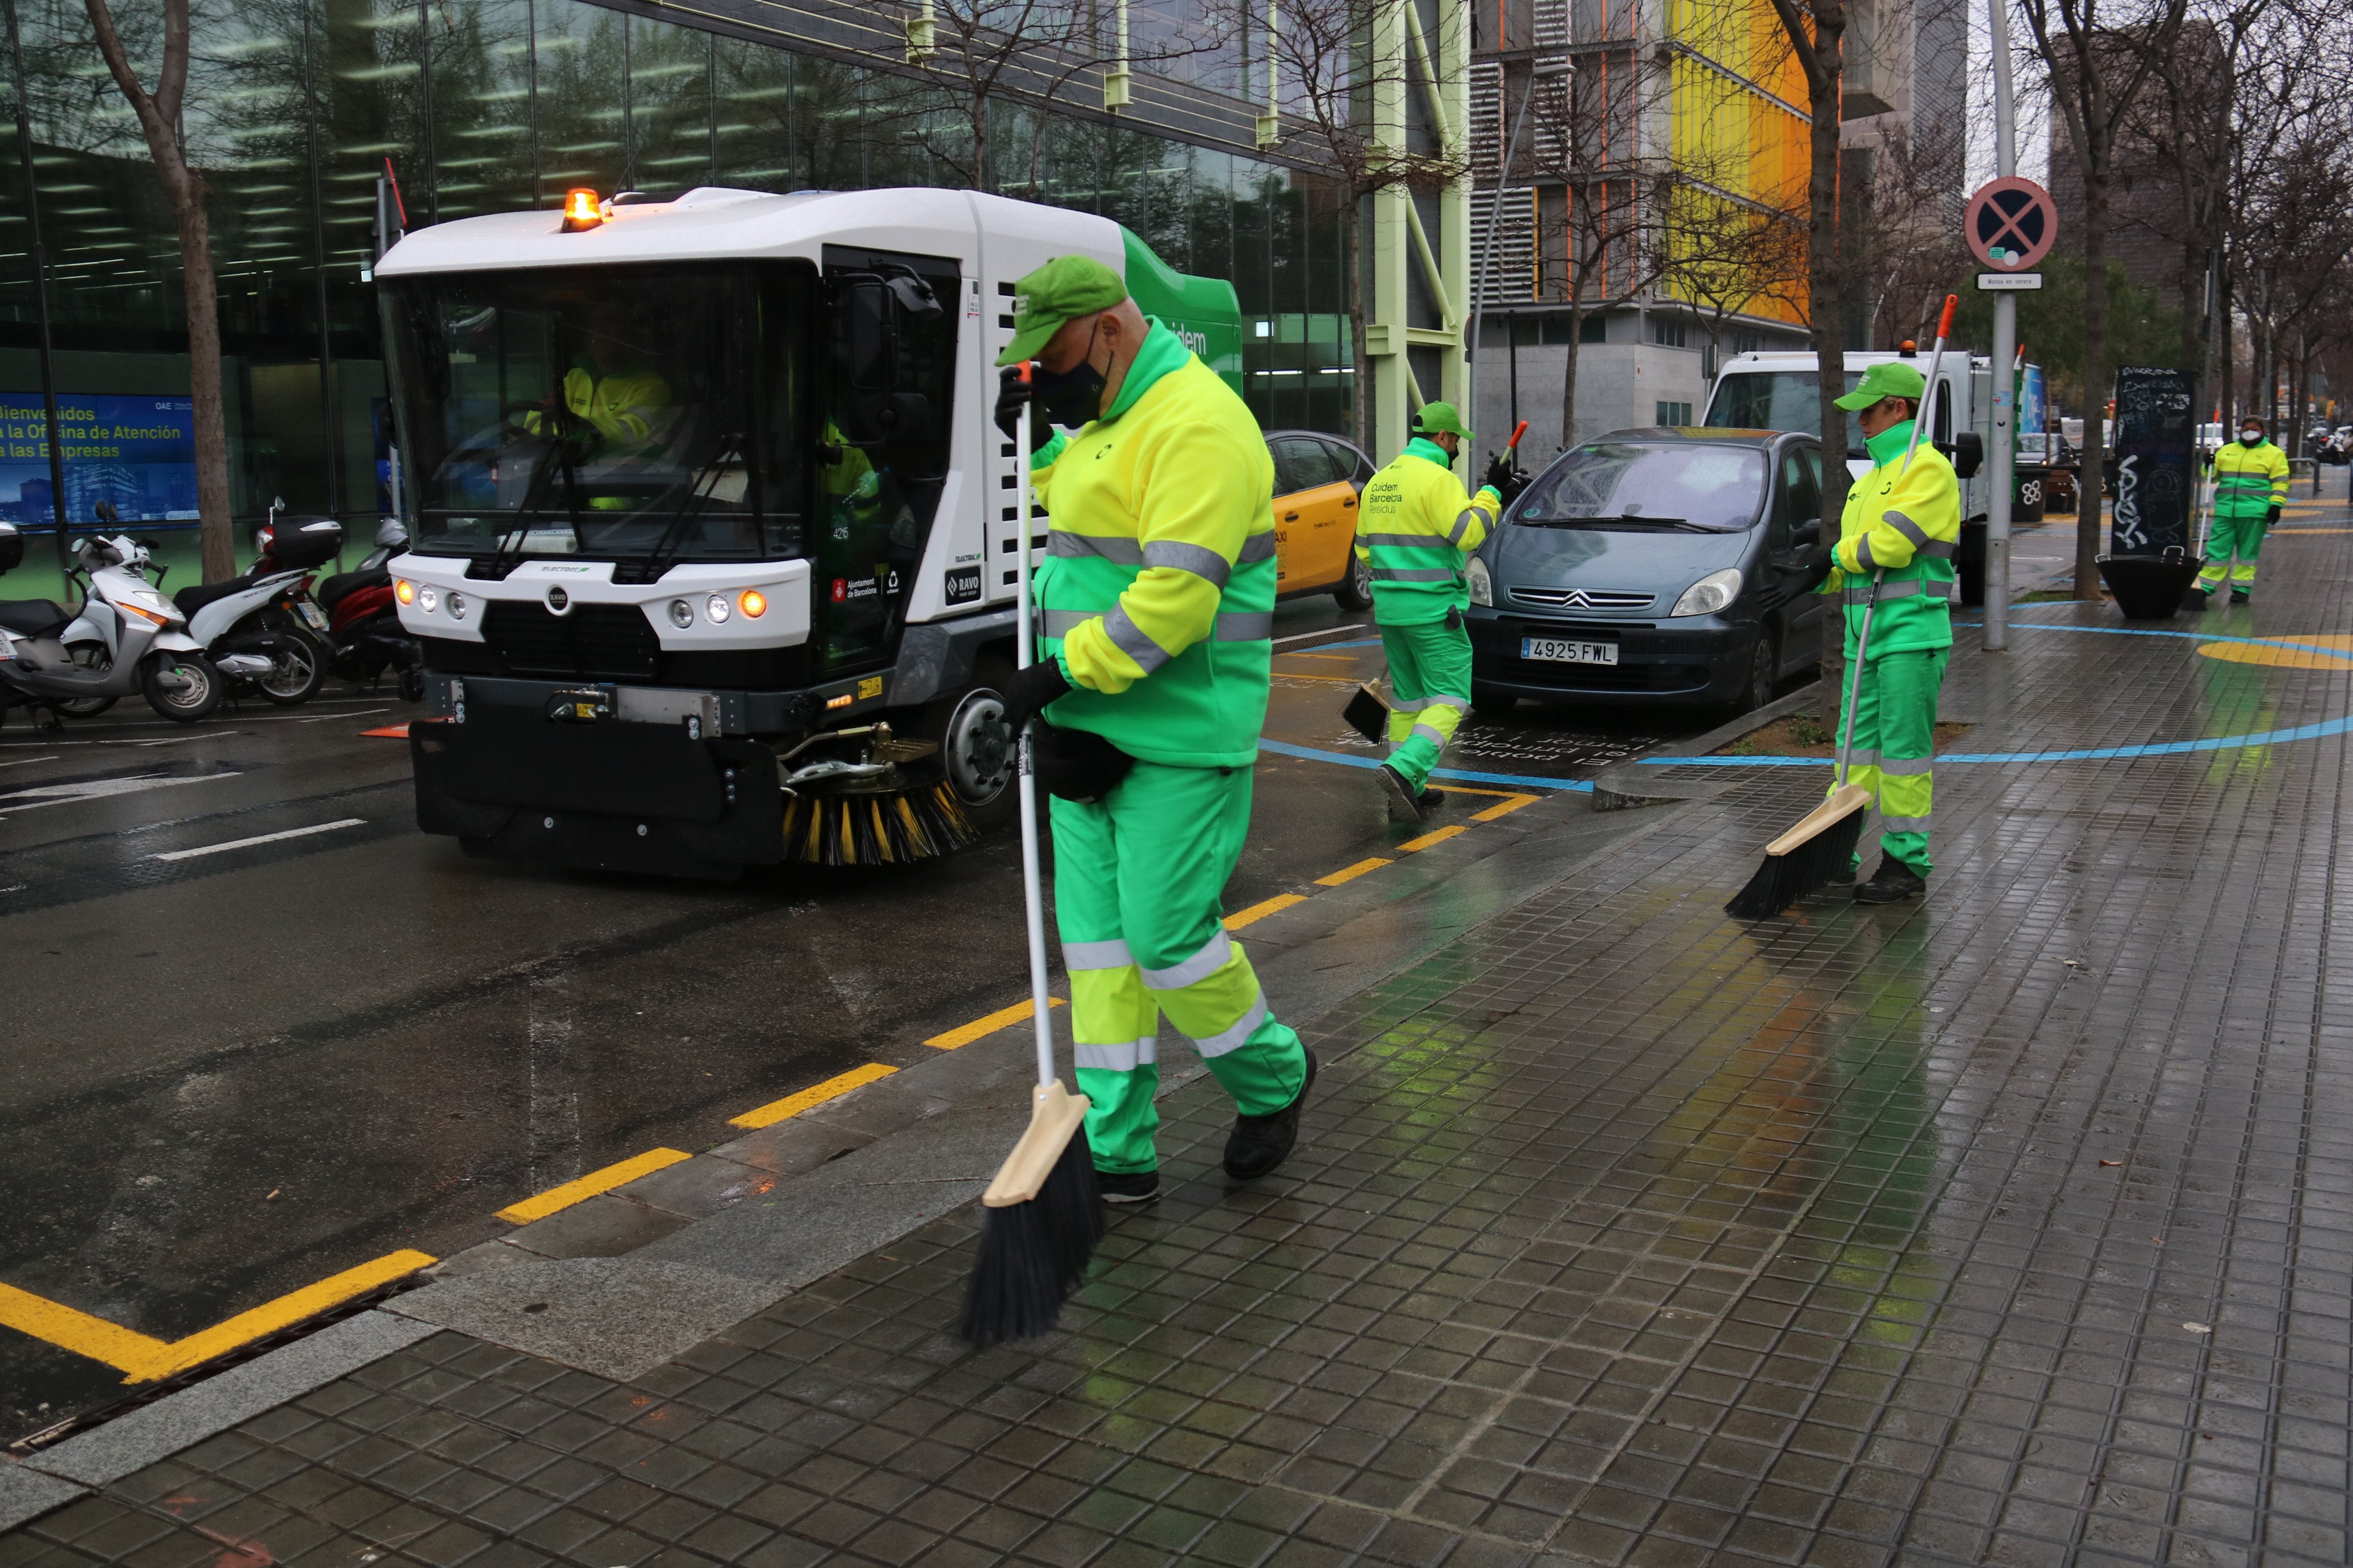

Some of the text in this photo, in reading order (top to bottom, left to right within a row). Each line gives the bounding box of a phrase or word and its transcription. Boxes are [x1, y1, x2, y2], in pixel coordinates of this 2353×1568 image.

[8, 424, 24, 439] la
[28, 424, 86, 439] Ofina
[90, 425, 109, 439] de
[113, 425, 181, 439] Atención
[9, 443, 34, 457] las
[1371, 482, 1398, 492] Cuidem
[1369, 504, 1396, 515] Residus
[833, 527, 849, 539] 4215
[1275, 530, 1287, 543] AXI
[847, 578, 875, 589] Ajuntament
[959, 576, 978, 591] RAVO
[854, 587, 876, 597] Barcelona
[1534, 641, 1612, 662] 4925 FWL
